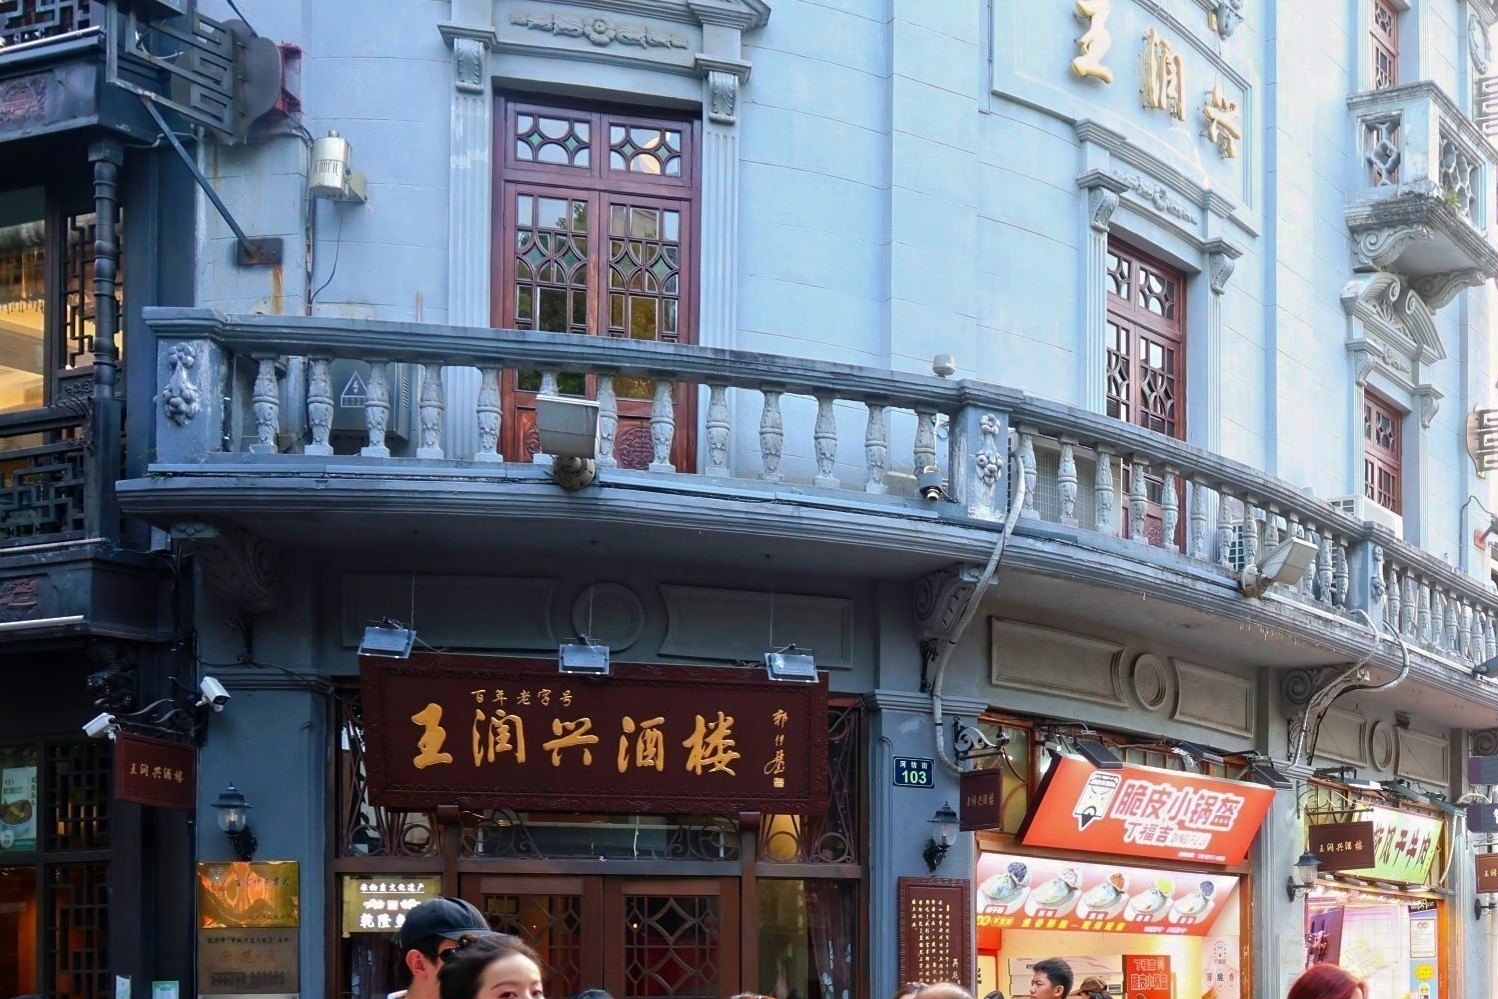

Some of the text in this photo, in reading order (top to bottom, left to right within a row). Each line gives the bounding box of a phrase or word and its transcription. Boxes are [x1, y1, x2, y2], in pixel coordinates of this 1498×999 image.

[470, 689, 574, 707] 百年老字号
[410, 703, 742, 776] 王润兴酒楼
[899, 760, 928, 770] 河坊街
[901, 770, 927, 784] 103
[1112, 781, 1244, 831] 脆皮小锅盔
[1124, 820, 1174, 844] 丁福吉
[1319, 839, 1364, 854] 王润兴酒楼
[1131, 973, 1168, 991] 脆皮小锅盔
